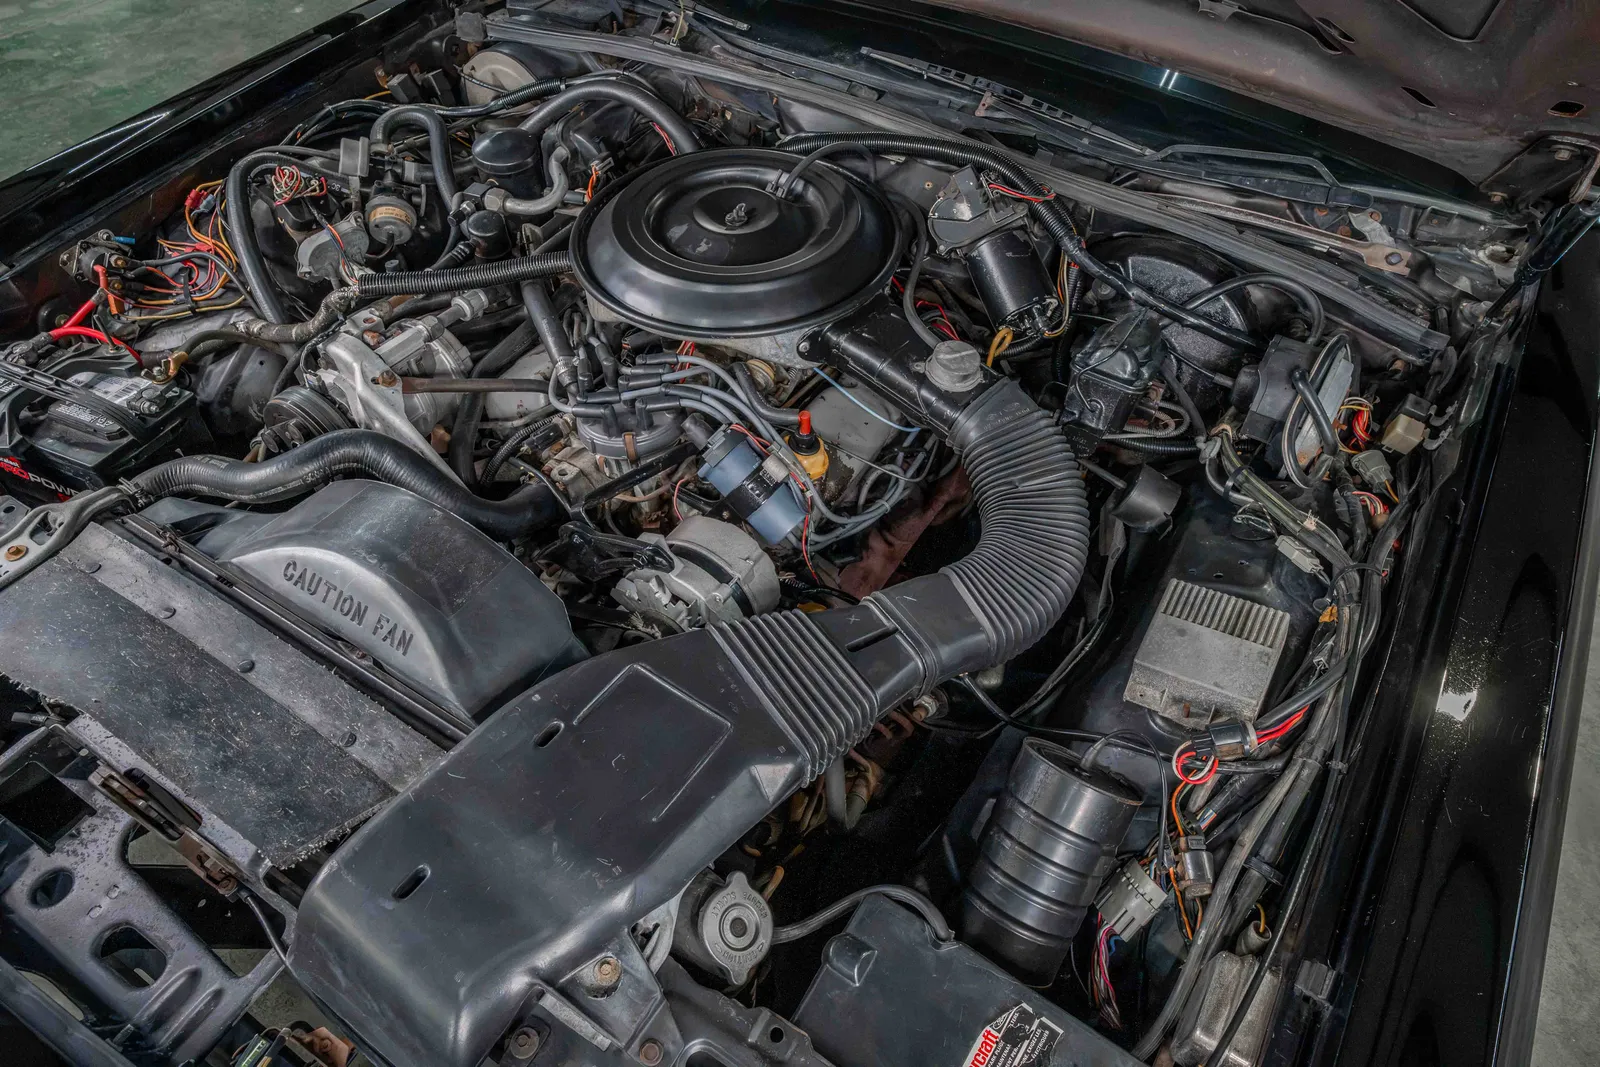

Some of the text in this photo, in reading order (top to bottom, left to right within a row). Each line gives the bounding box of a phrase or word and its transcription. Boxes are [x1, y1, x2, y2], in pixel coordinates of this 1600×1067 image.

[283, 560, 414, 656] CAUTION FAN
[967, 1028, 1000, 1067] rcraft
